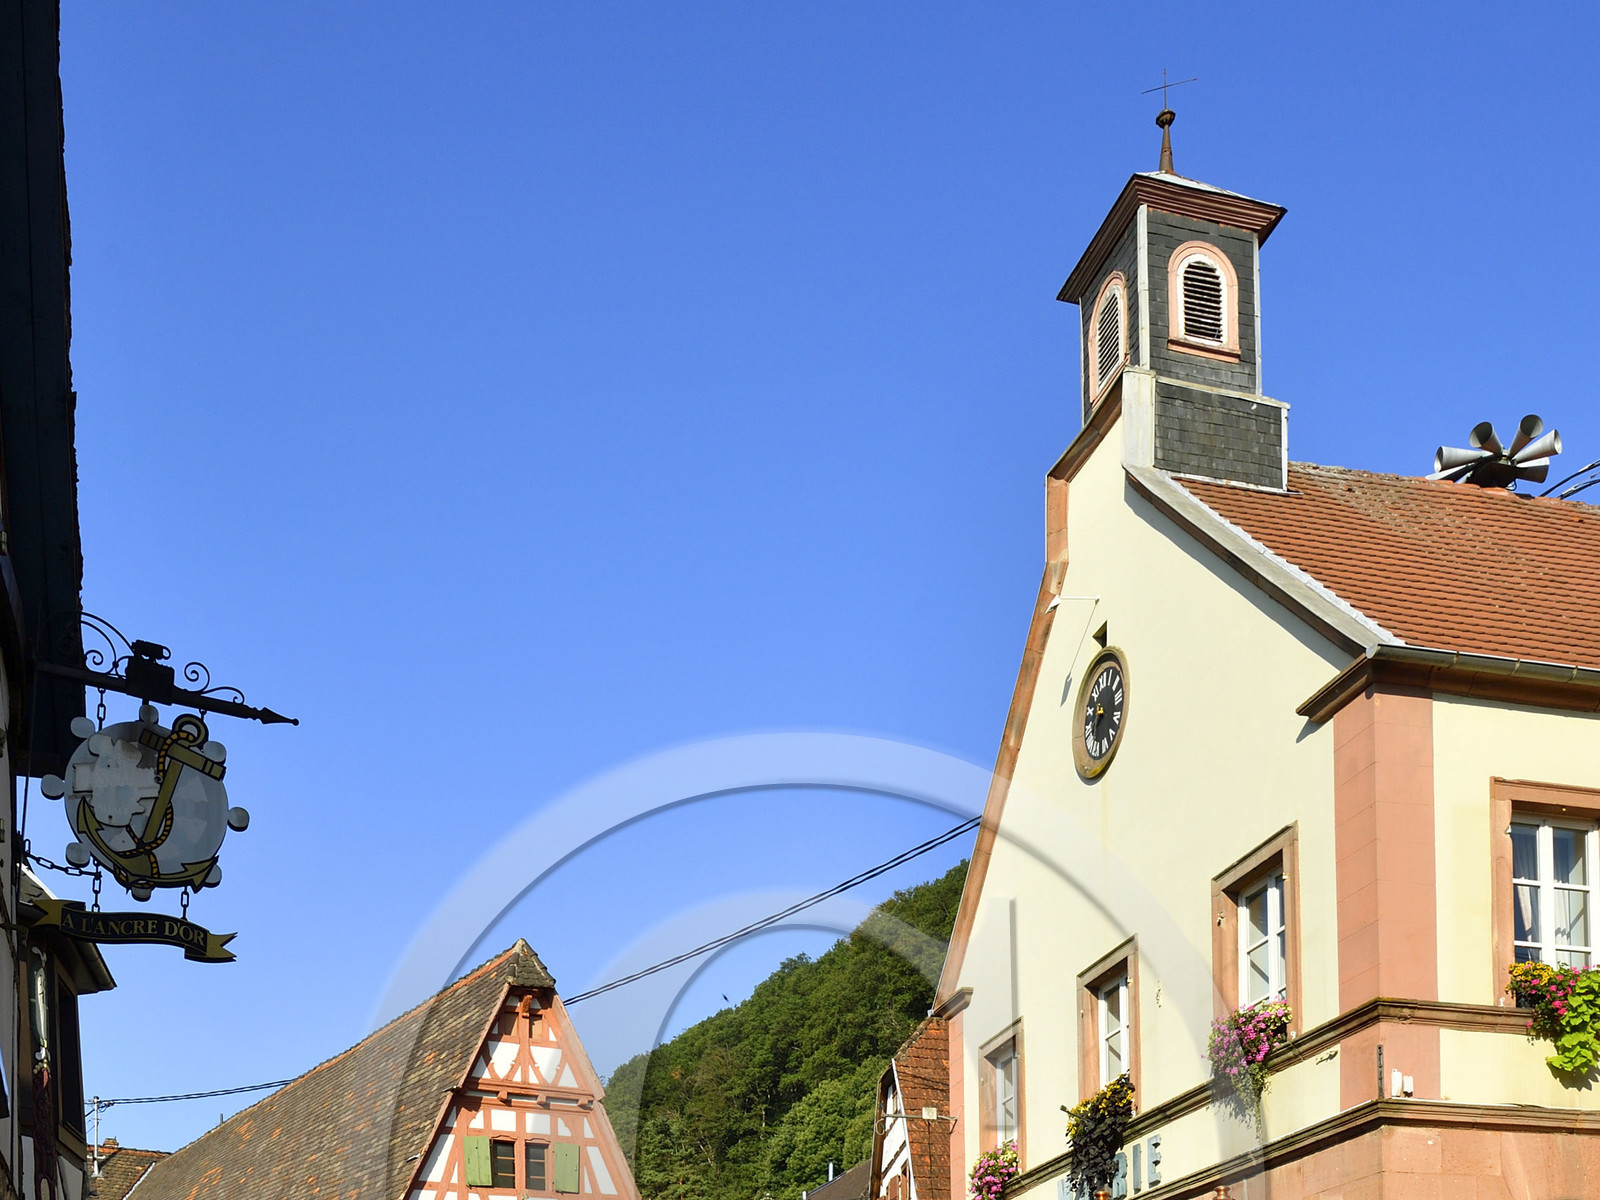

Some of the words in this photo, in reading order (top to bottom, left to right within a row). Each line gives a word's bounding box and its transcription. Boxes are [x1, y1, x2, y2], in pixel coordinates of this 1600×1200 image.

[62, 913, 75, 929] A
[81, 917, 158, 935] L'ANCRE
[164, 921, 205, 946] D'OR
